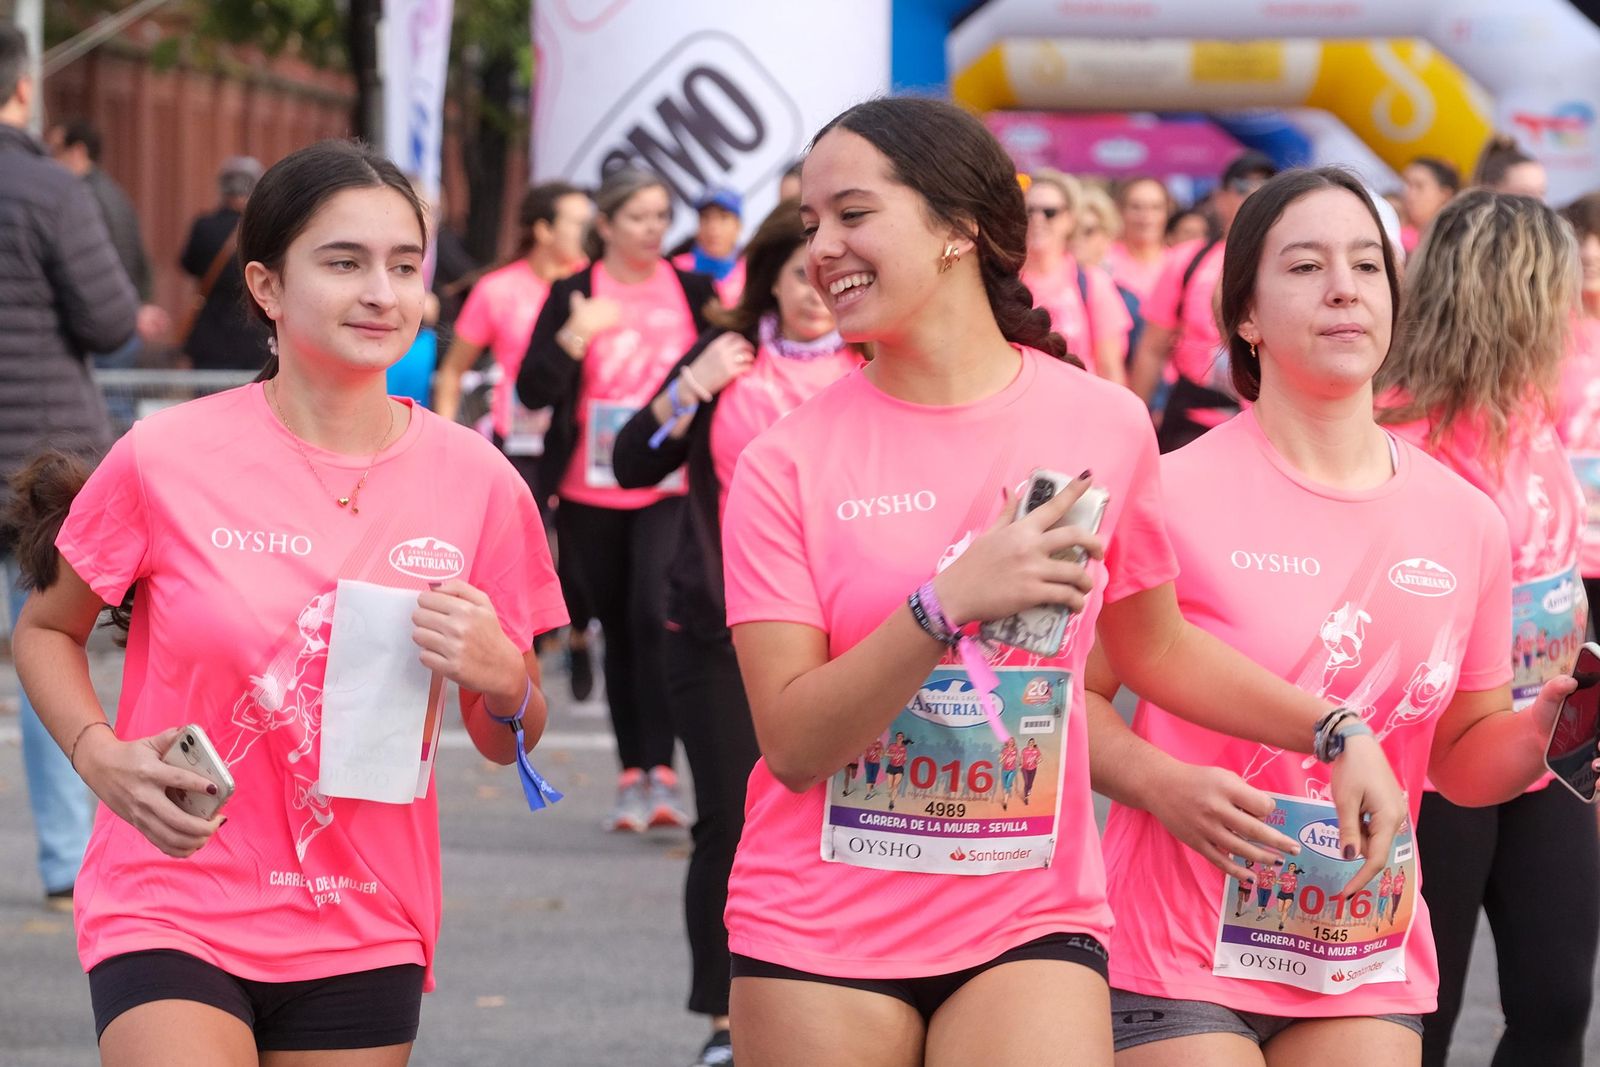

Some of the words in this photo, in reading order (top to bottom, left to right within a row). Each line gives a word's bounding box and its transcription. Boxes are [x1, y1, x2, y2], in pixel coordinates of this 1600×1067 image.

[836, 490, 938, 521] OYSHO
[211, 527, 312, 556] OYSHO
[395, 549, 459, 571] ASTURIANA
[1231, 550, 1321, 576] OYSHO
[1395, 569, 1452, 589] ASTURIANA
[909, 756, 995, 793] 016
[925, 801, 967, 818] 4989
[859, 813, 908, 829] CARRERA
[910, 819, 926, 831] DE
[927, 821, 941, 832] LA
[943, 822, 981, 834] MUJER
[988, 820, 1029, 834] SEVILLA
[849, 836, 922, 860] OYSHO
[968, 849, 1033, 862] Santander
[338, 876, 378, 895] MUJER
[314, 892, 341, 908] 2024
[1298, 885, 1373, 920] 016
[1250, 932, 1296, 948] CARRERA
[1298, 940, 1311, 951] DE
[1313, 943, 1325, 955] LA
[1327, 946, 1358, 957] MUJER
[1363, 939, 1388, 954] SEVILLA
[1312, 926, 1349, 943] 1545
[1240, 952, 1307, 976] OYSHO
[1346, 961, 1385, 982] Santander
